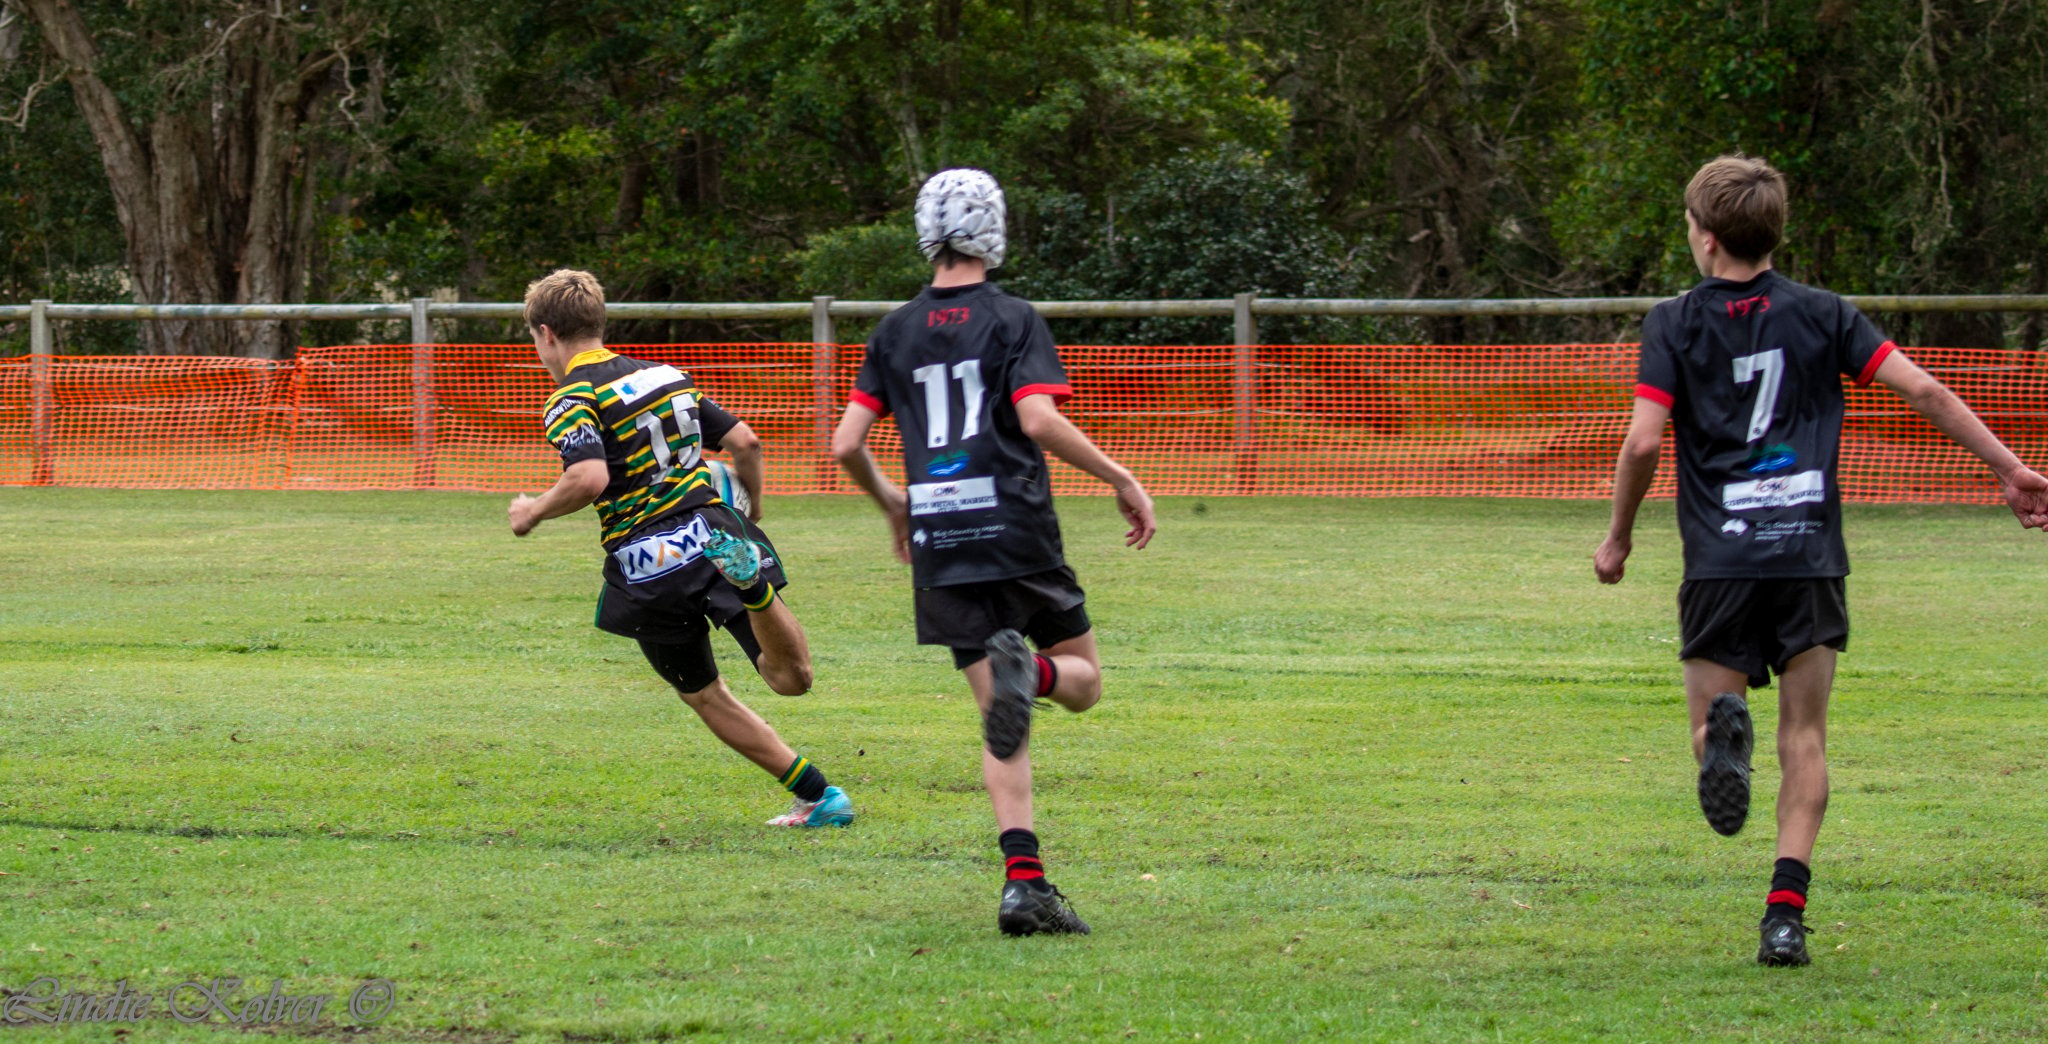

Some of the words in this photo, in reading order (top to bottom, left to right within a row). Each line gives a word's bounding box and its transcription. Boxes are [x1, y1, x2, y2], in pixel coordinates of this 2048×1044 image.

[927, 307, 970, 327] 1973
[636, 393, 702, 485] 15
[912, 359, 986, 448] 11
[1732, 347, 1785, 444] 7
